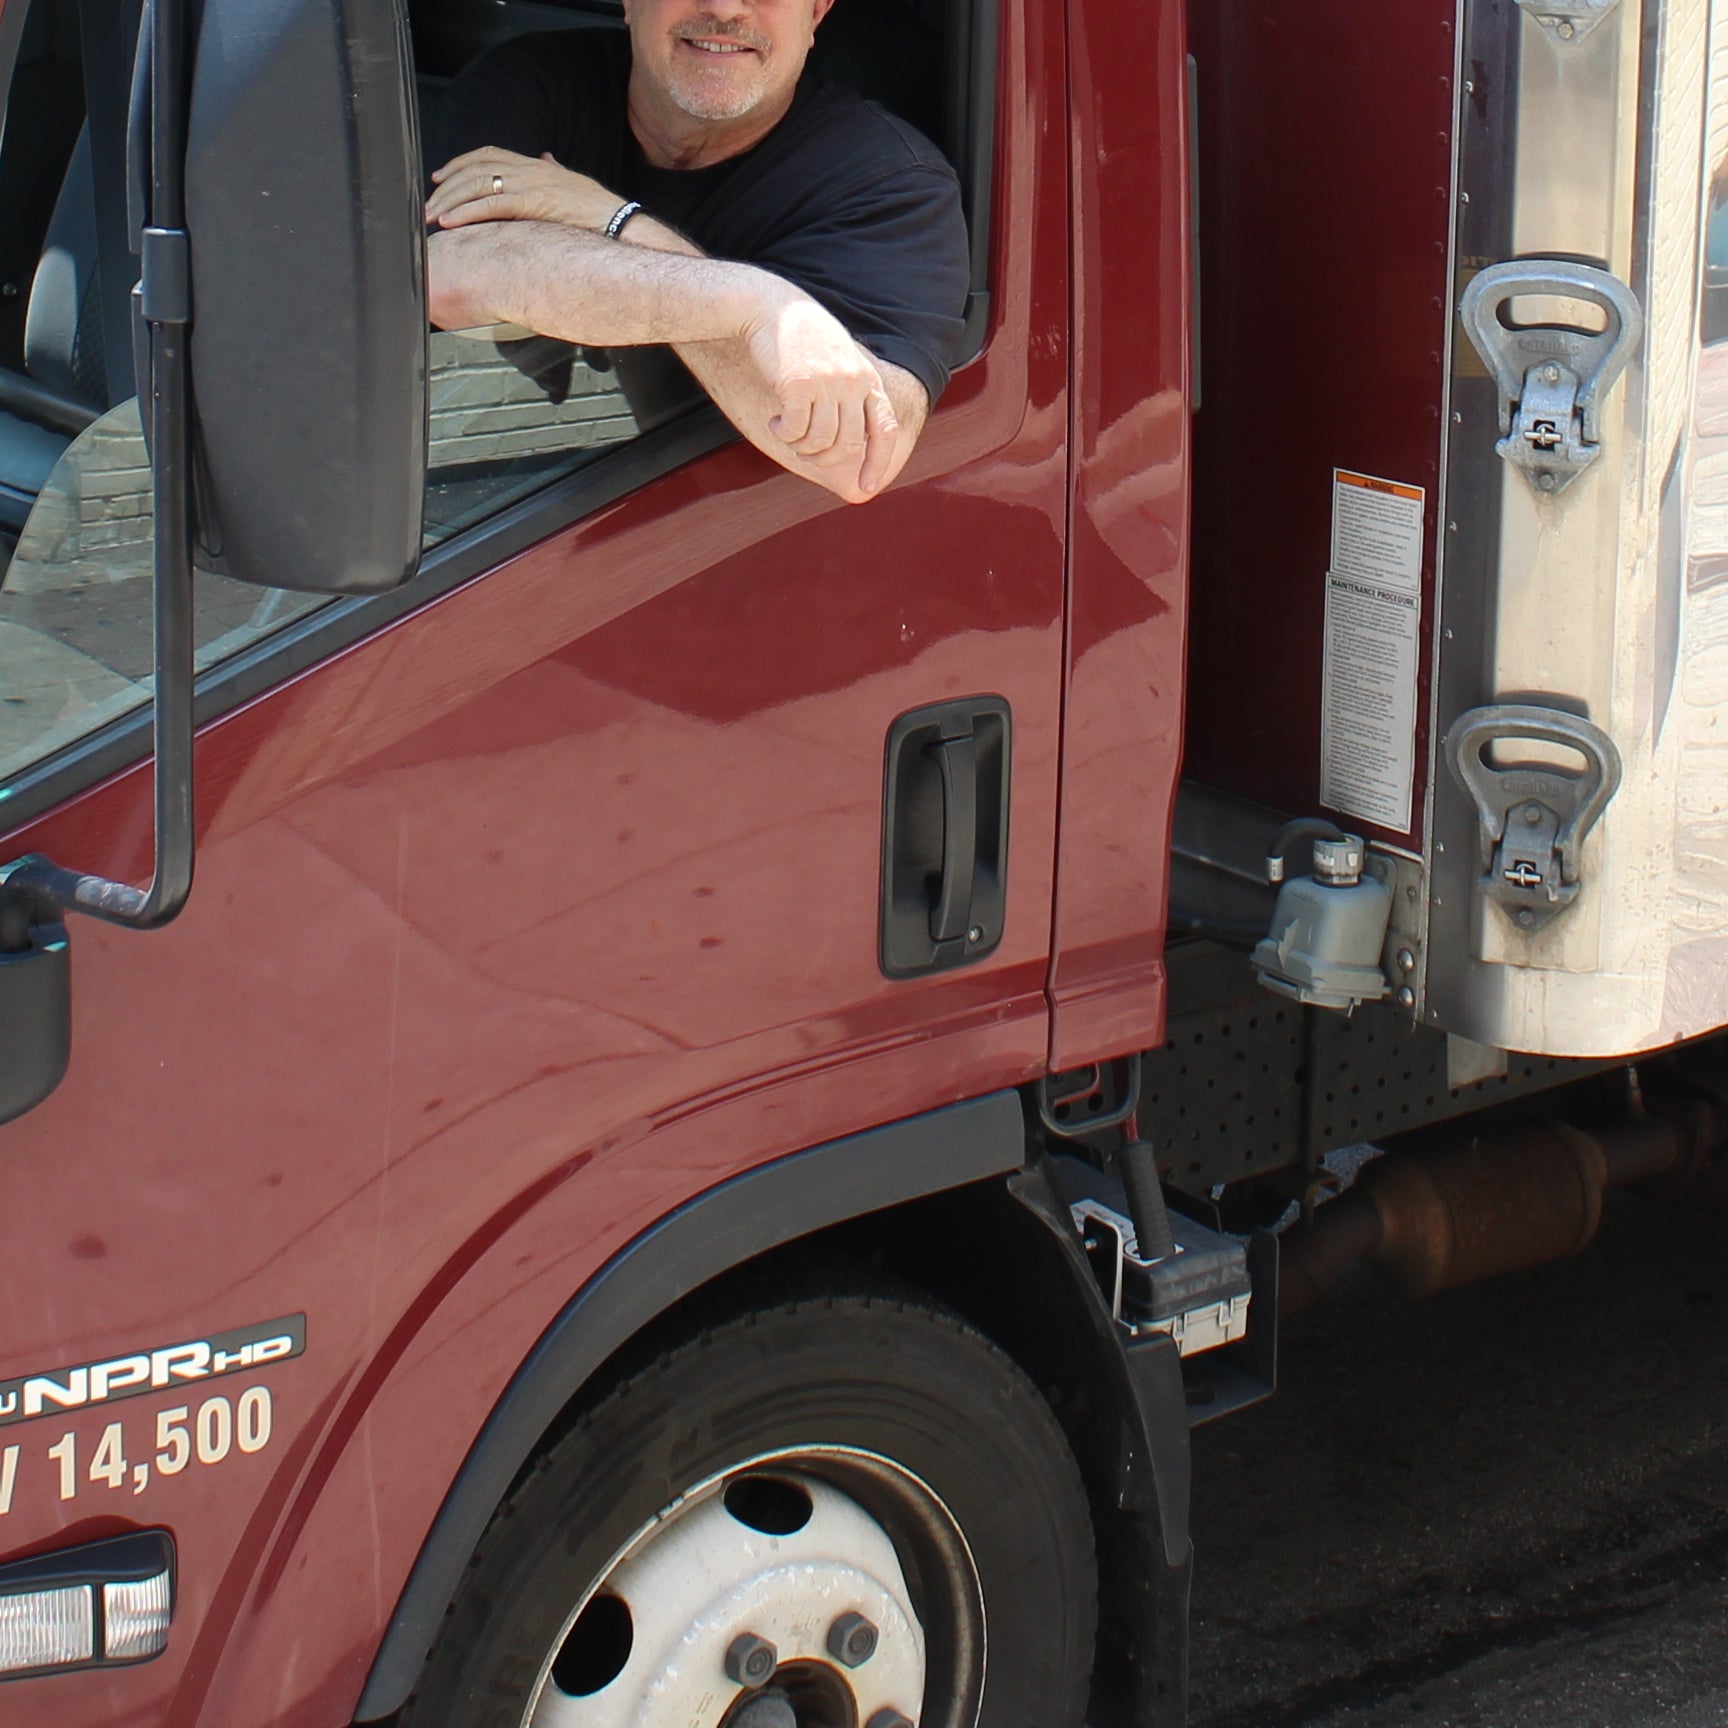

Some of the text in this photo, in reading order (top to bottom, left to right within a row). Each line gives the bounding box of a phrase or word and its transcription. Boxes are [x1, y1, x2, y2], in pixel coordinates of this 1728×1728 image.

[1331, 579, 1376, 597] MAINTENANCE
[24, 1341, 211, 1415] NPR
[214, 1335, 293, 1375] HD
[48, 1384, 274, 1500] 14,500
